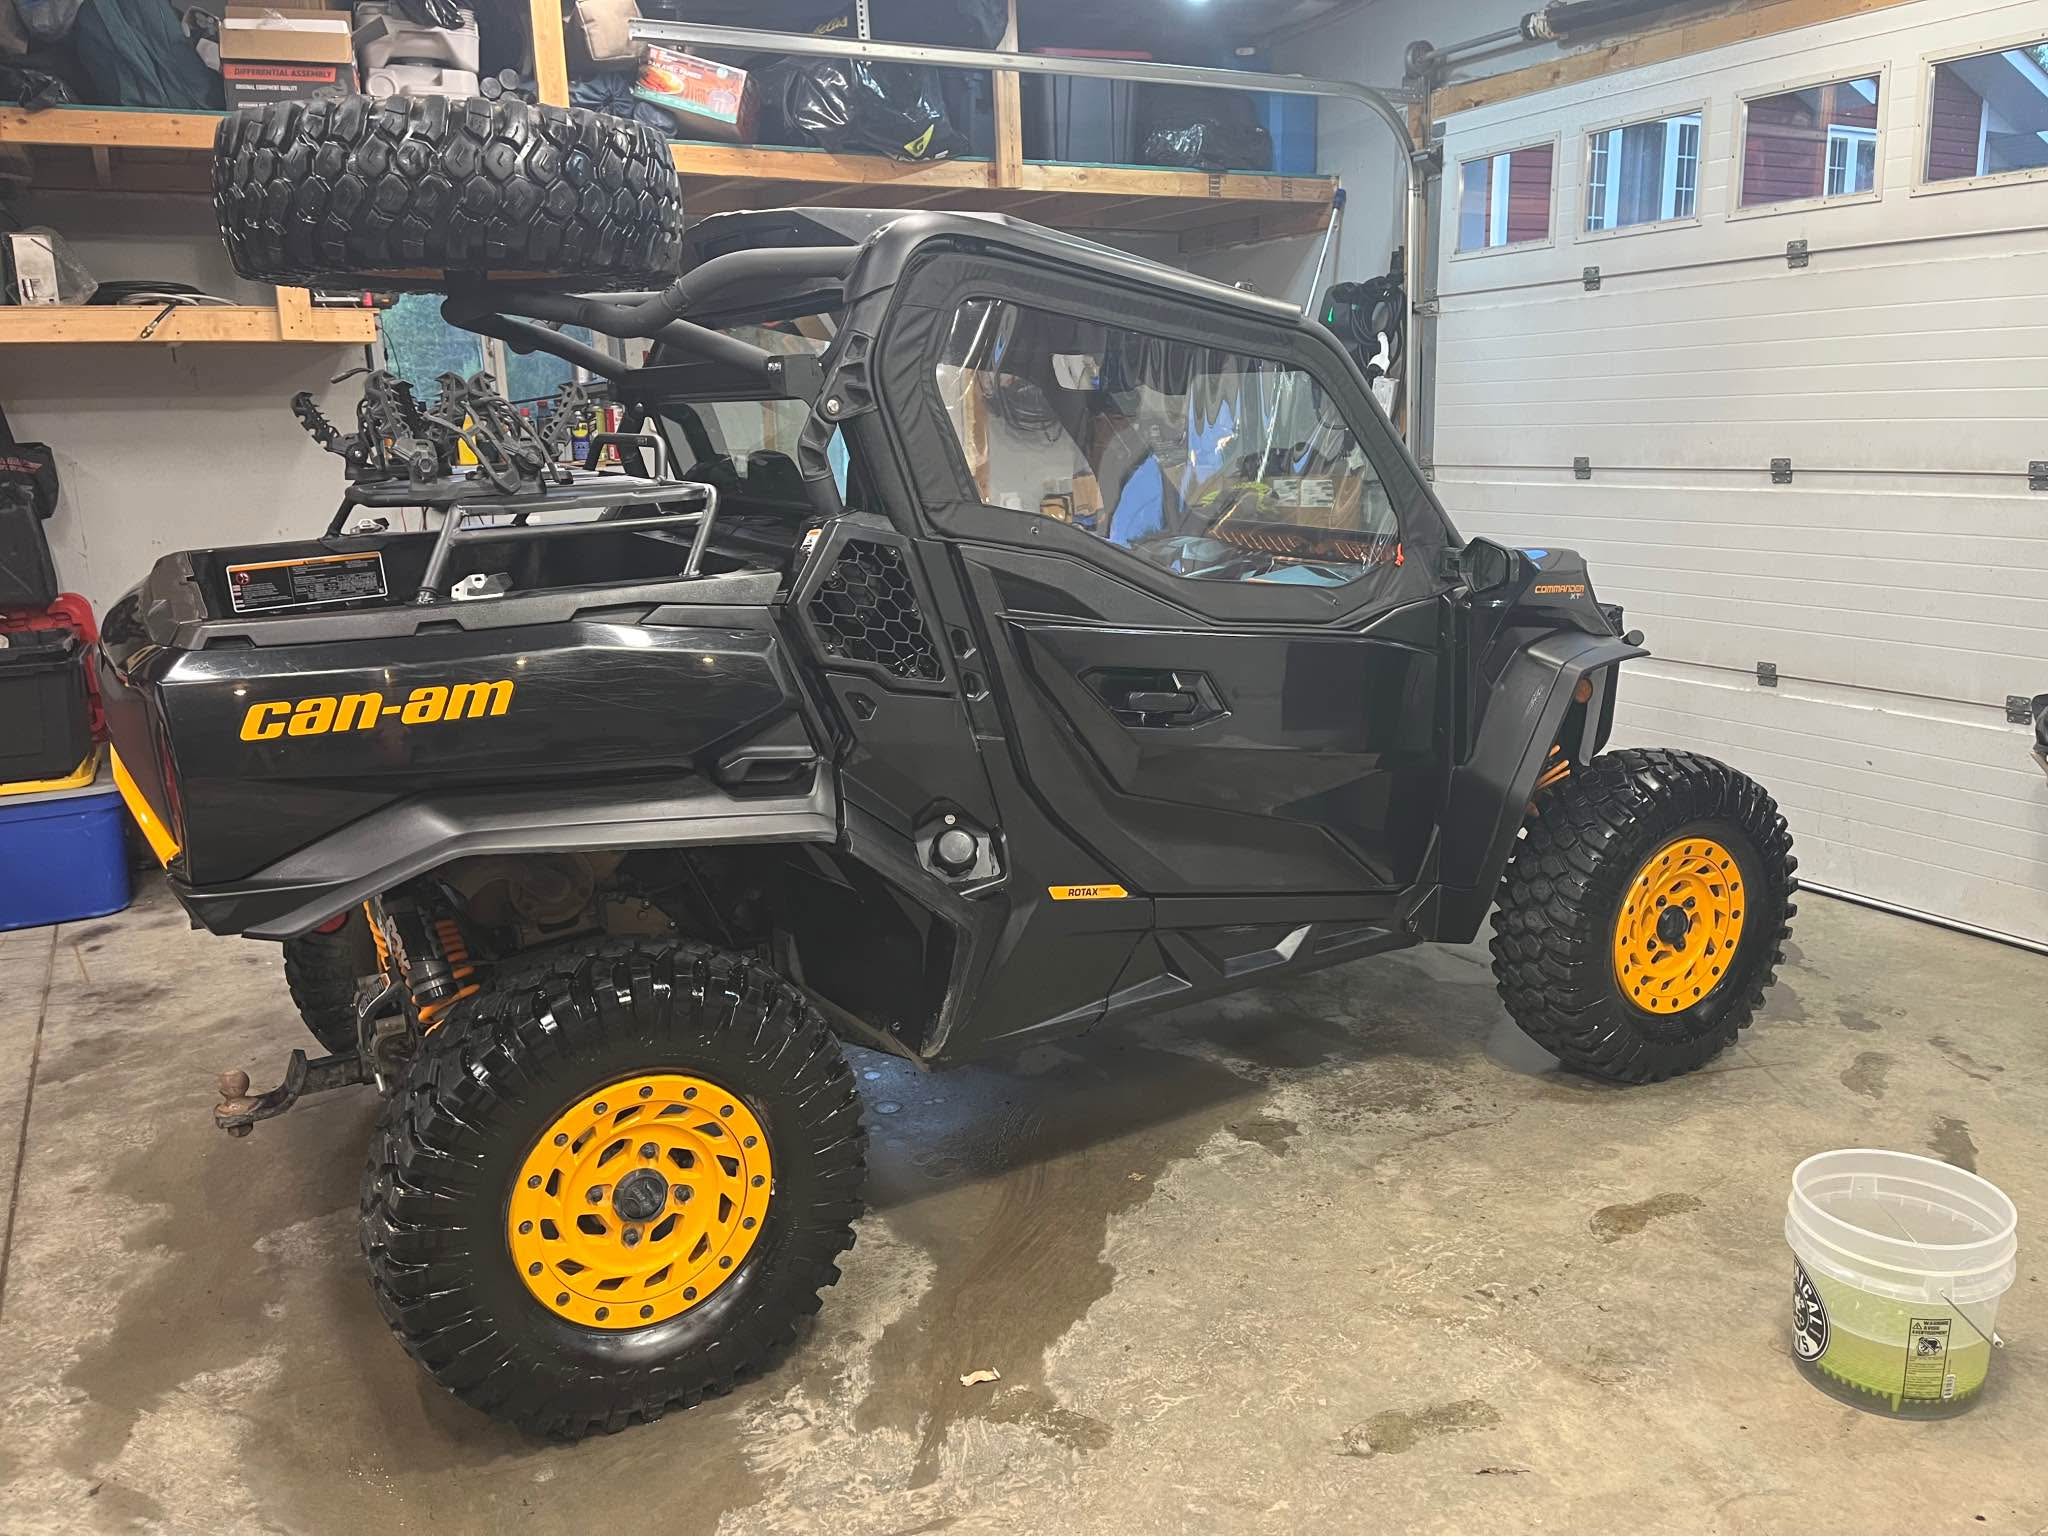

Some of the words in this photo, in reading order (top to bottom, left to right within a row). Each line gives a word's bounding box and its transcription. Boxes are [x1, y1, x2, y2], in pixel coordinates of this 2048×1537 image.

[234, 67, 289, 77] DIFFERENTIAL
[291, 69, 332, 79] ASSEMBLY
[1535, 584, 1585, 594] COMMANDER
[239, 679, 515, 741] can-am
[1068, 887, 1098, 897] ROTAX
